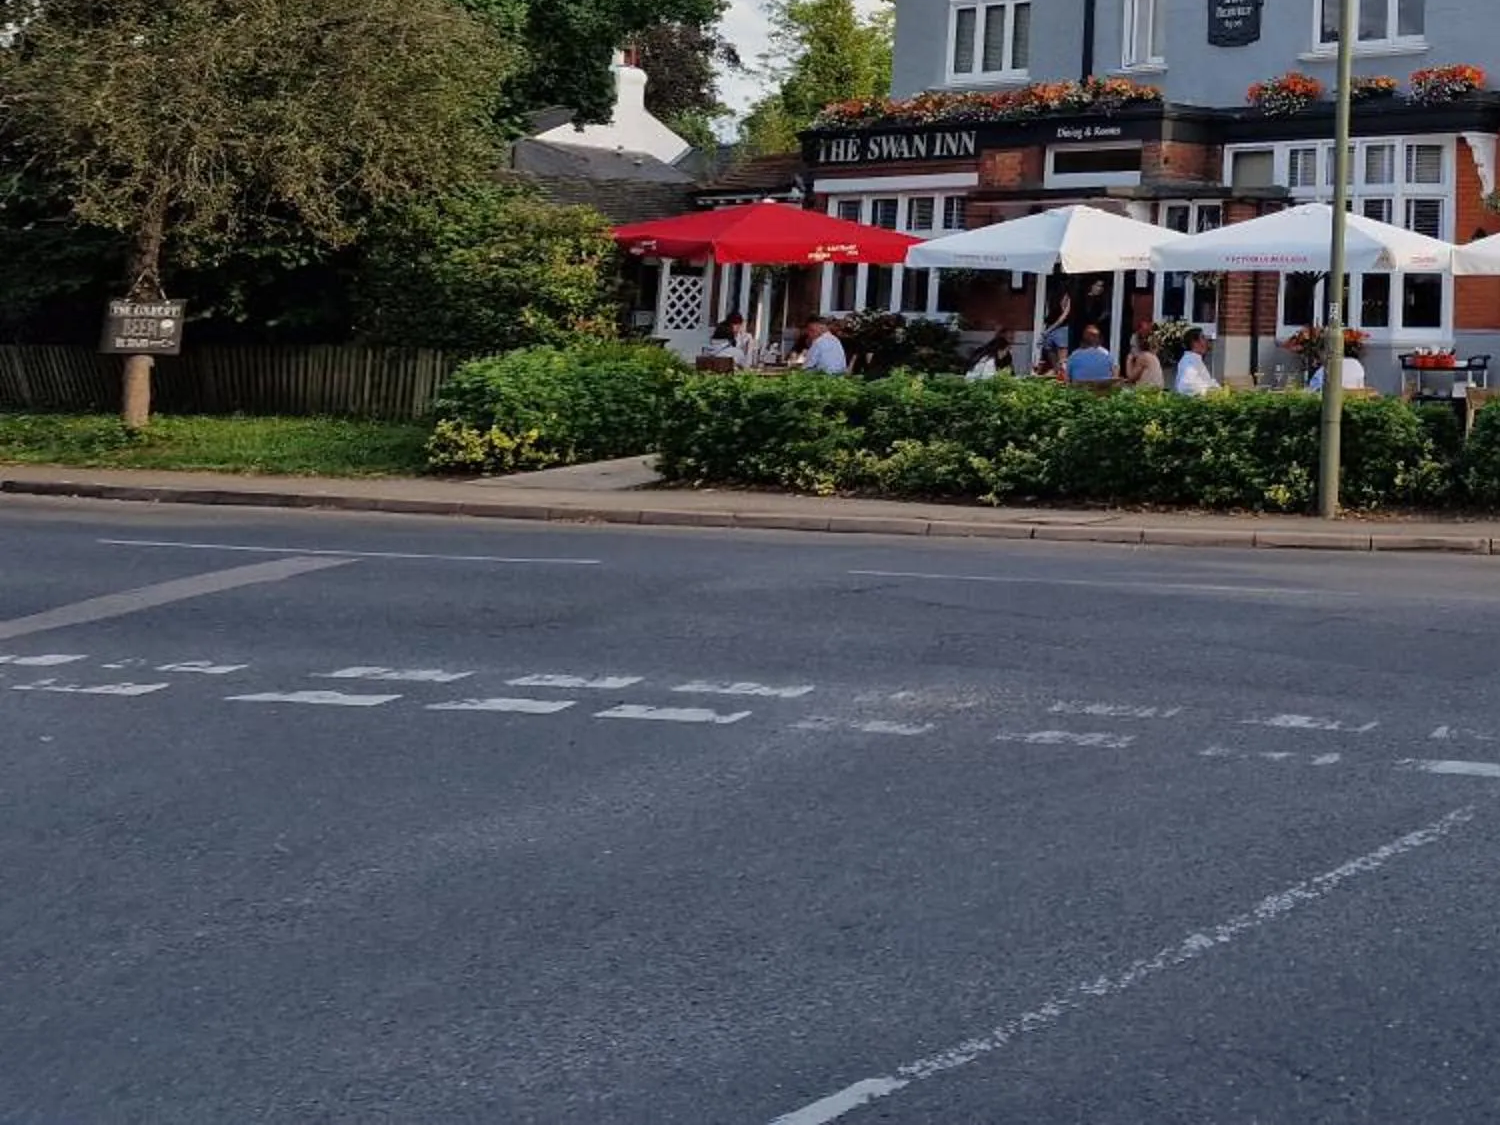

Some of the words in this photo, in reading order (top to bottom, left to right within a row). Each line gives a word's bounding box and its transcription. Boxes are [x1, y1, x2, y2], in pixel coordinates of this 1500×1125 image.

[818, 137, 861, 163] THE
[867, 133, 927, 160] SWAN
[933, 130, 977, 156] INN
